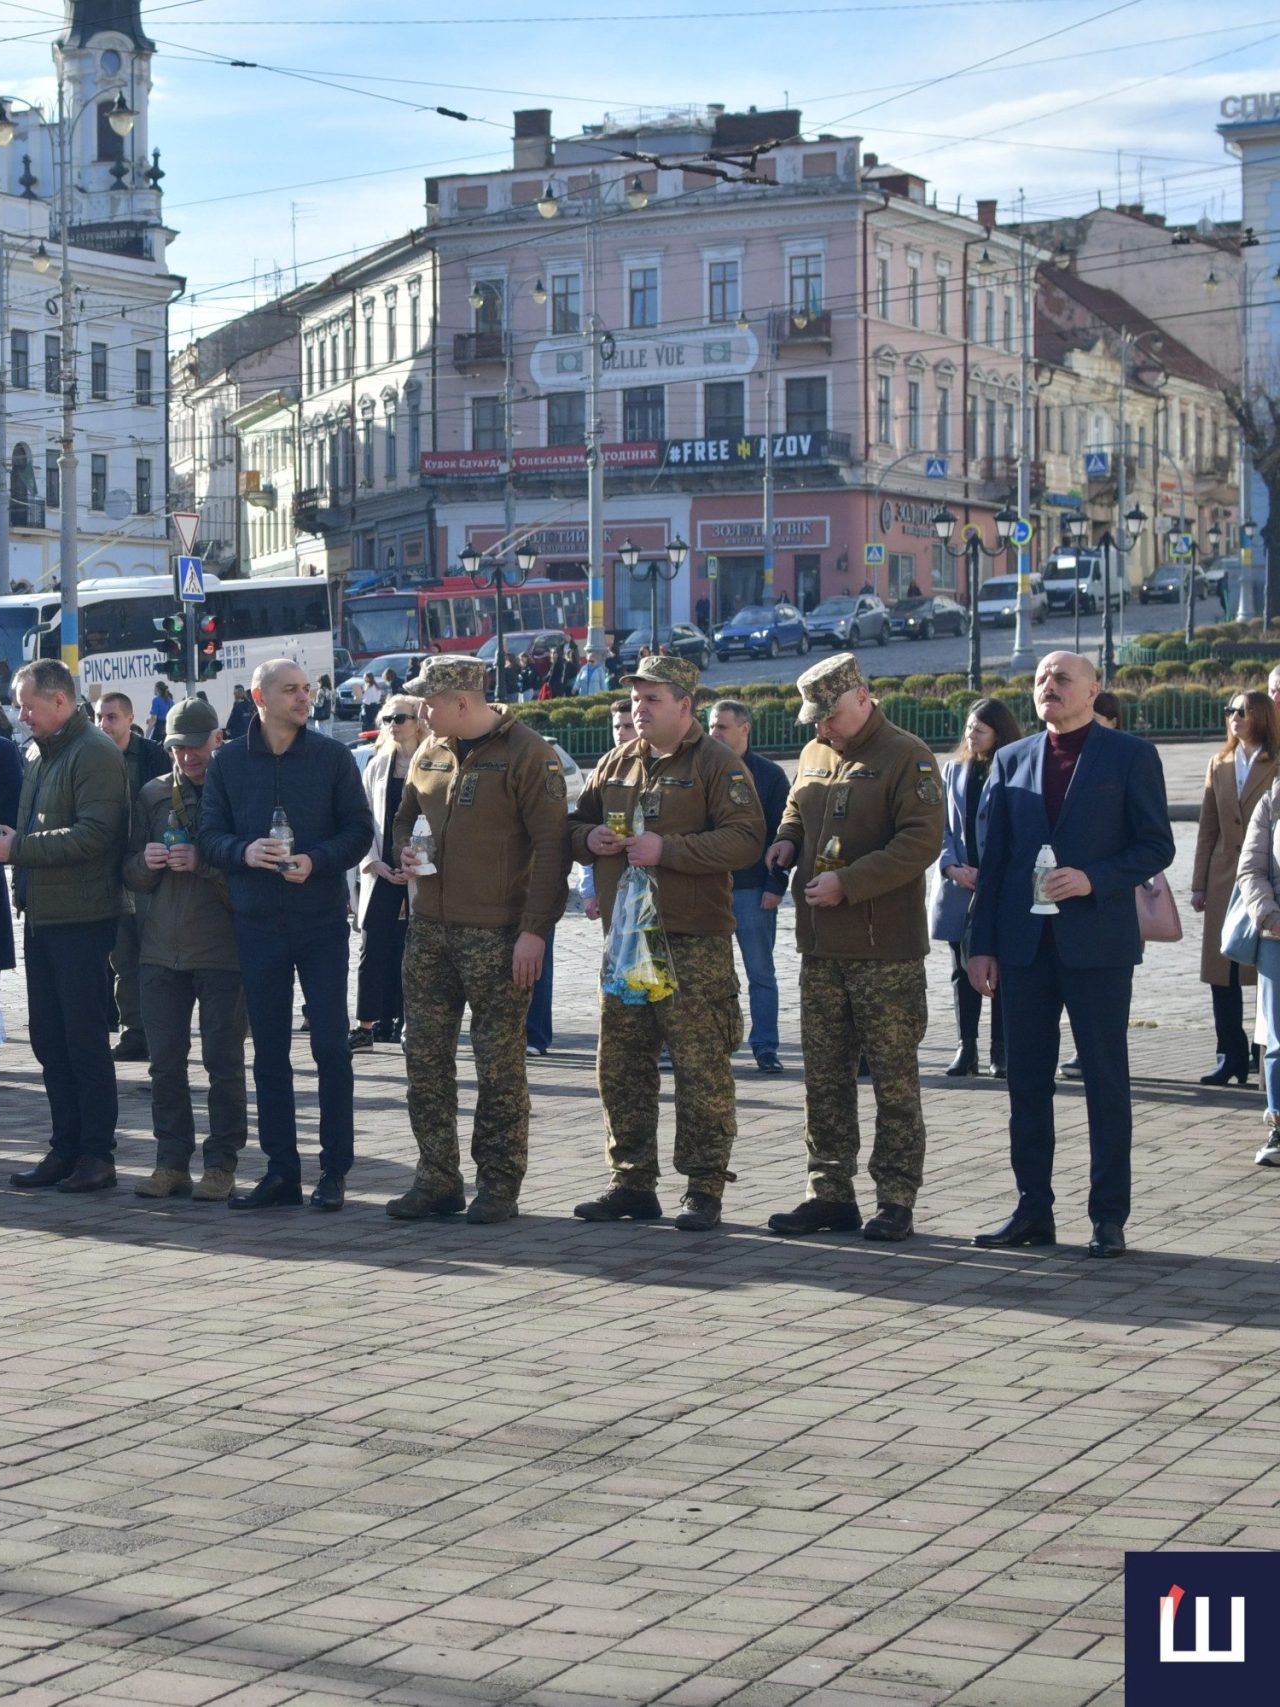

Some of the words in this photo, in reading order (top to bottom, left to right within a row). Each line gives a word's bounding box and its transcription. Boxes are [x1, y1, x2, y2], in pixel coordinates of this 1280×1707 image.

[656, 345, 685, 366] VUE
[598, 449, 657, 462] ОГОДІНИХ
[669, 439, 730, 464] #FREE
[759, 434, 812, 458] AZOV
[527, 527, 586, 543] ОЛОТИЙ
[712, 521, 782, 536] ЗОЛОТЙ
[788, 521, 813, 535] ВІК
